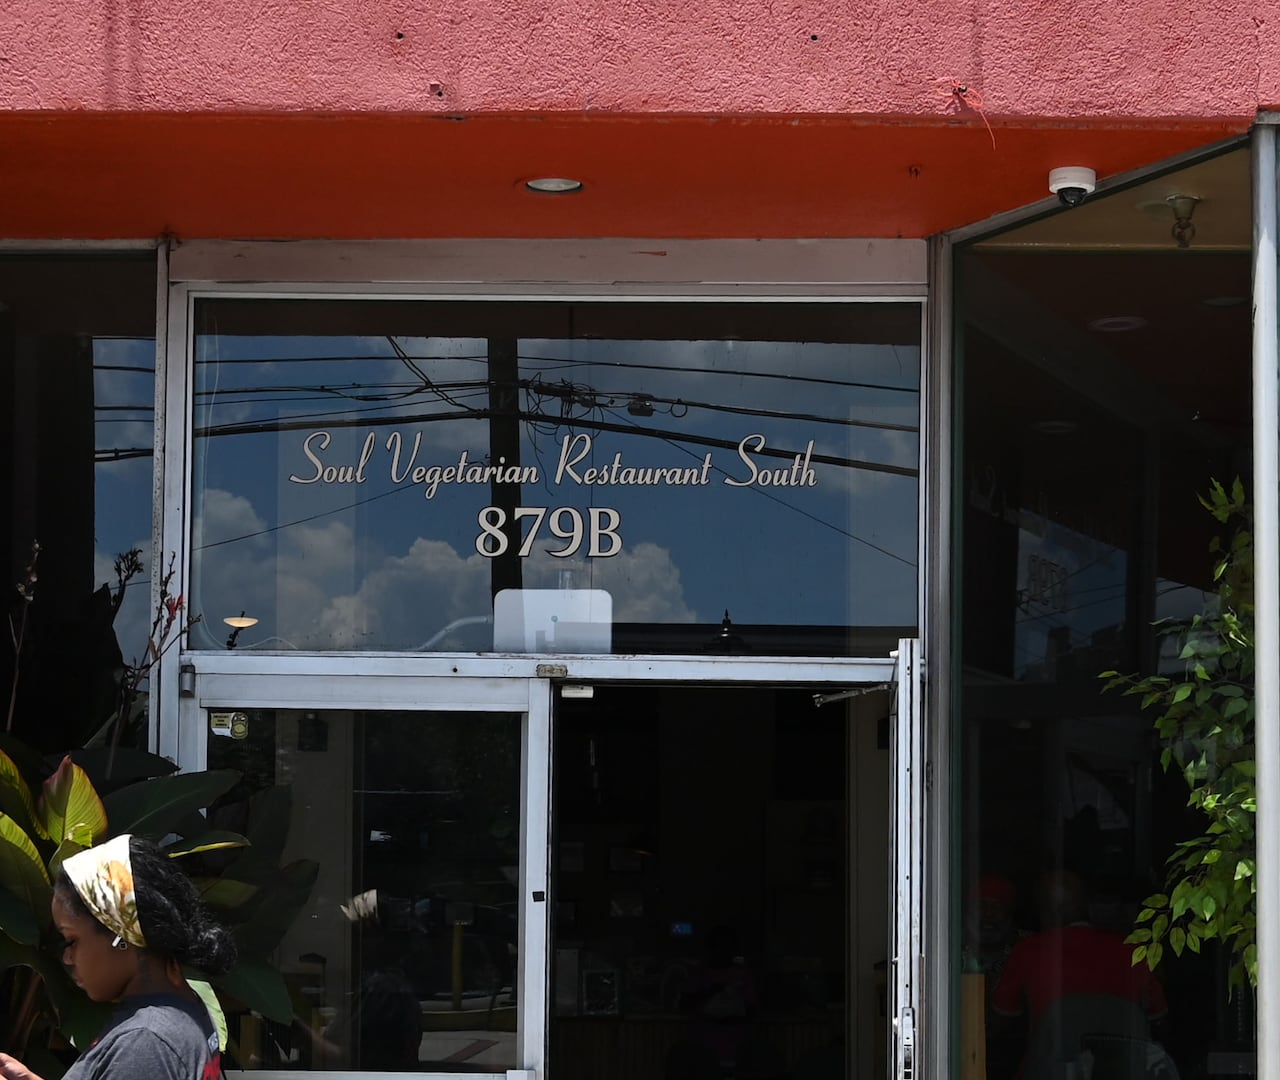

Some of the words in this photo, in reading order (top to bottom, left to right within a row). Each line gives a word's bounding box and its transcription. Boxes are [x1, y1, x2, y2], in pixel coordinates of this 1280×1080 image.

[289, 431, 375, 485] Soul
[386, 431, 539, 500] Vegetarian
[555, 433, 714, 487] Restaurant
[724, 433, 818, 488] South
[474, 506, 624, 558] 879B
